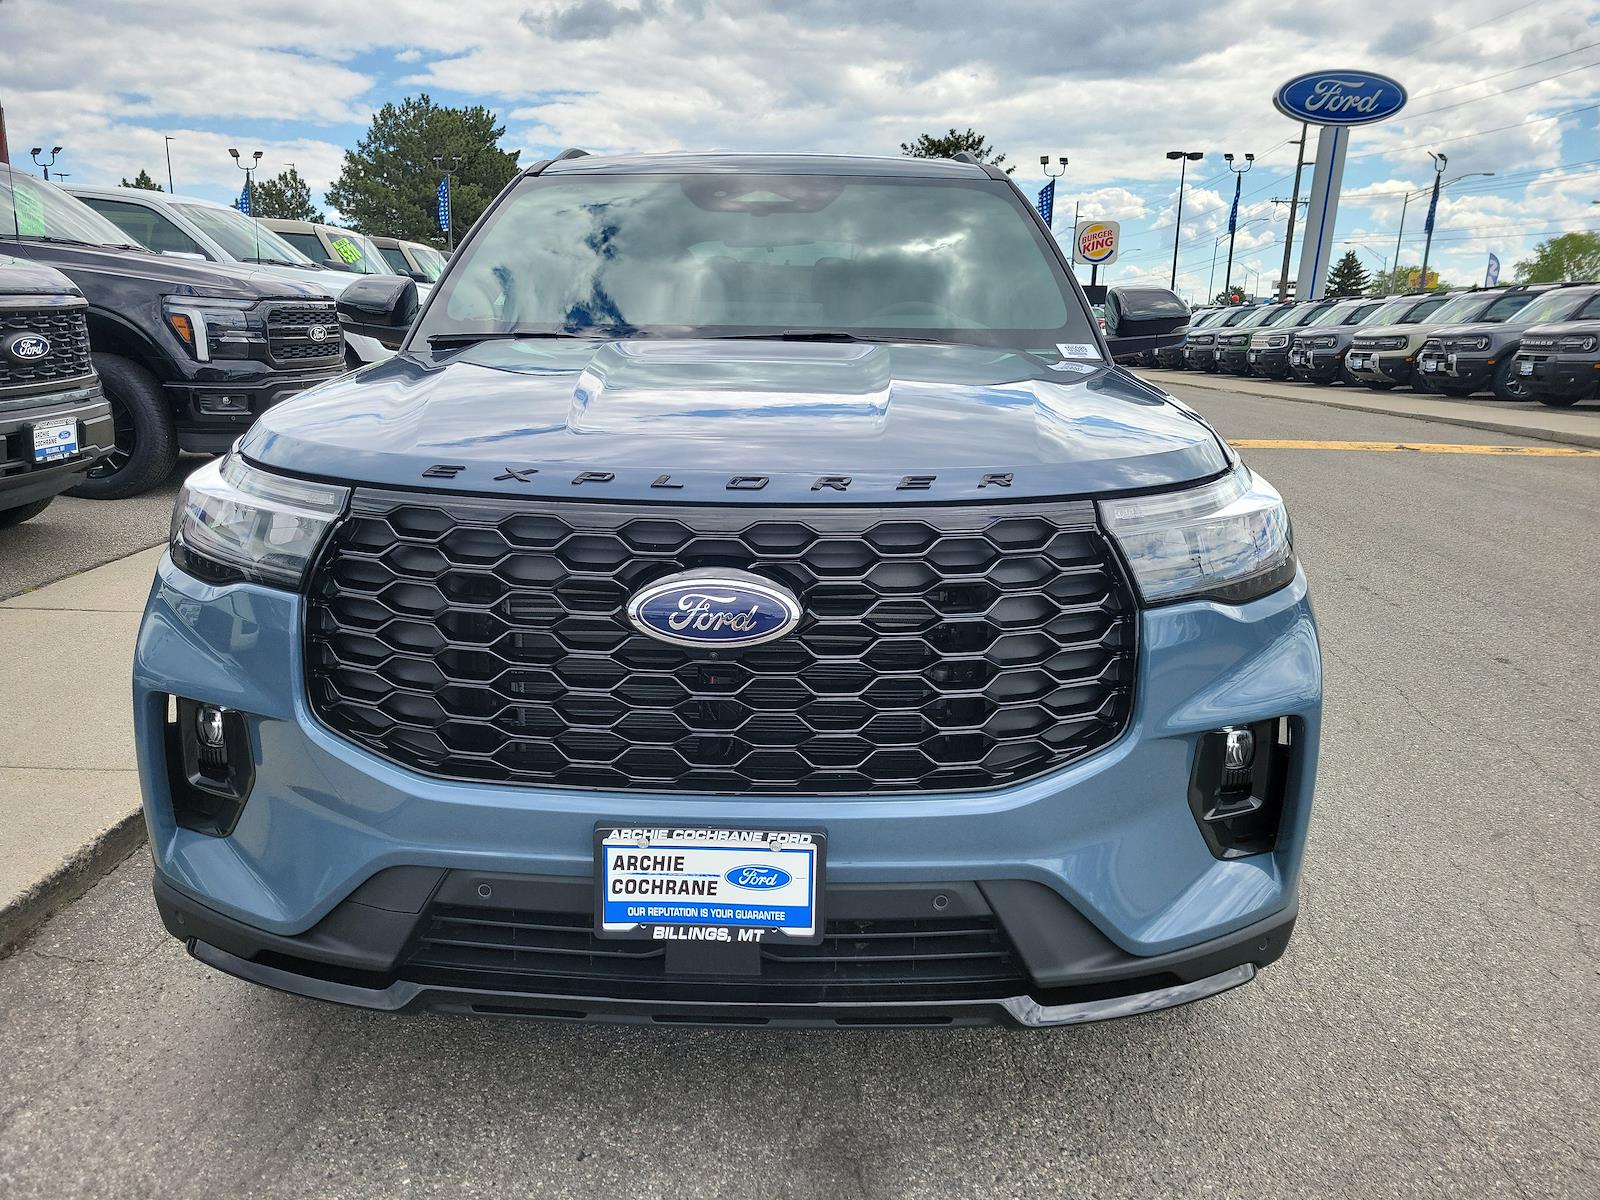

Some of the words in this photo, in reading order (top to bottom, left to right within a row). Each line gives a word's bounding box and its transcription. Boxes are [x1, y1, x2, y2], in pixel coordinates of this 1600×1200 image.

[1304, 79, 1383, 112] Ford
[1082, 230, 1113, 244] BURGER
[1082, 236, 1114, 255] KING
[19, 339, 44, 355] Ford
[421, 463, 1015, 491] EXPLORER
[668, 593, 760, 632] Ford
[608, 829, 669, 841] ARCHIE
[672, 829, 764, 843] COCHRANE
[766, 832, 813, 845] FORD
[612, 855, 685, 872] ARCHIE
[738, 867, 778, 886] Ford
[612, 878, 718, 896] COCHRANE
[627, 906, 646, 917] OUR
[647, 907, 698, 918] REPUTATION
[700, 909, 709, 918] IS
[710, 909, 734, 919] YOUR
[735, 910, 786, 921] GUARANTEE
[652, 926, 732, 943] BILLINGS,
[737, 928, 765, 943] MT
